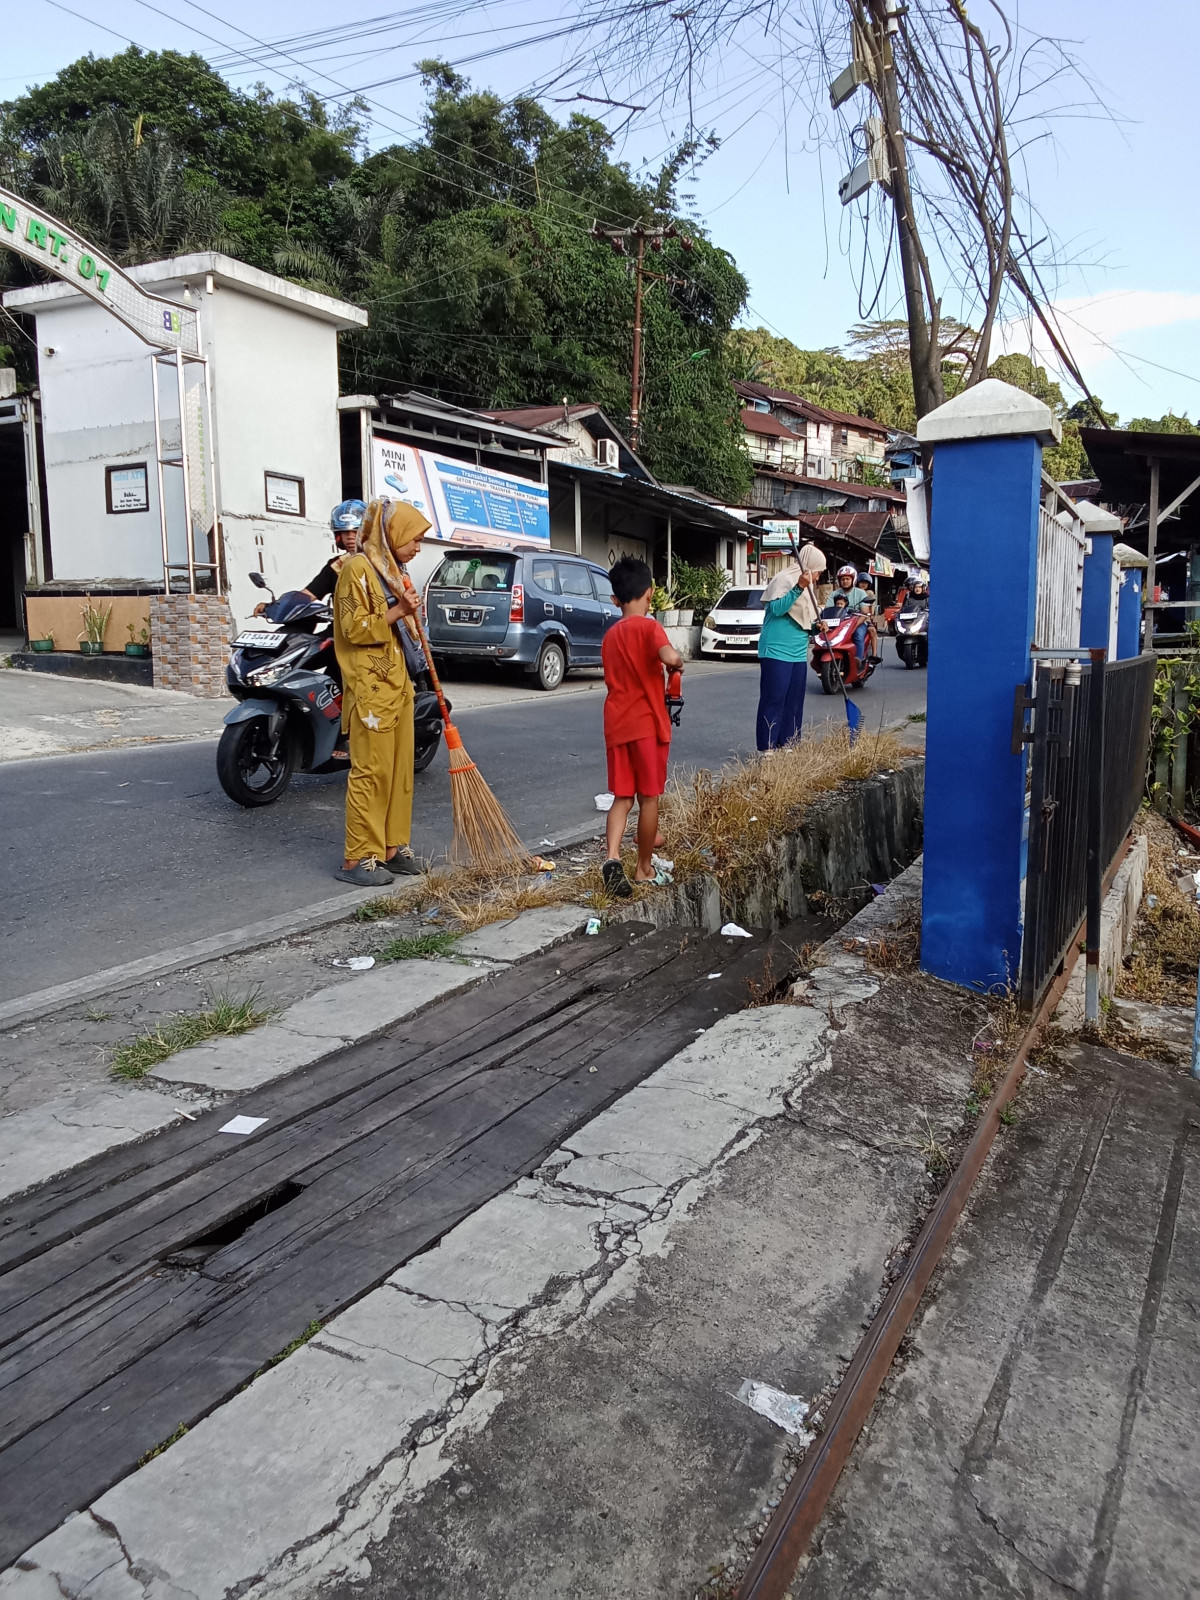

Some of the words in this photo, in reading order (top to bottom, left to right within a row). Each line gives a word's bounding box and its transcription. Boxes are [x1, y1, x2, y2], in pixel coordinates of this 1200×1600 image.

[25, 217, 69, 263] RT.
[78, 254, 110, 292] 01
[382, 448, 405, 461] MINI
[384, 460, 406, 471] ATM
[461, 470, 487, 481] Transaksi
[488, 476, 505, 486] Semua
[506, 481, 518, 490] Bank
